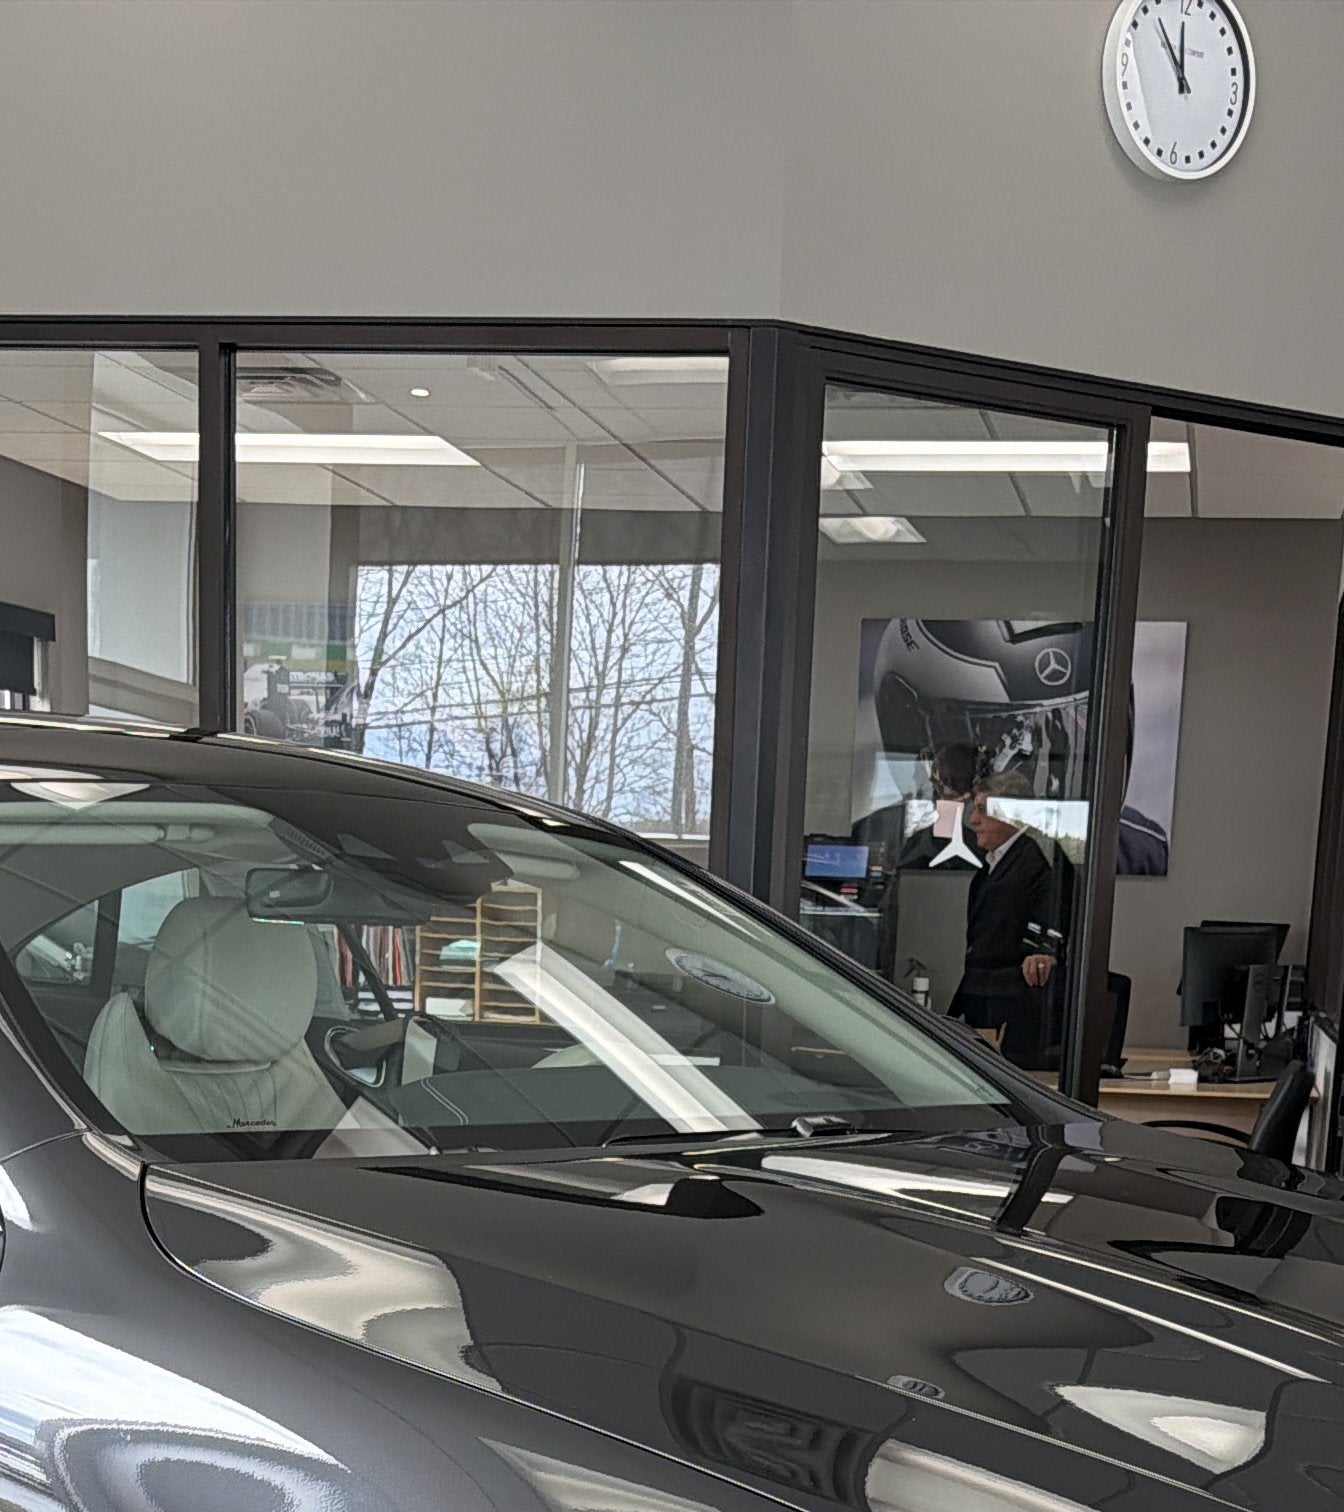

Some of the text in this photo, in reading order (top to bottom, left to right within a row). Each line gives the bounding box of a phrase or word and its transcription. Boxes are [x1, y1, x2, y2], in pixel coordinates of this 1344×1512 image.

[1121, 52, 1129, 77] 9
[1229, 81, 1239, 106] 3
[1169, 141, 1178, 165] 6
